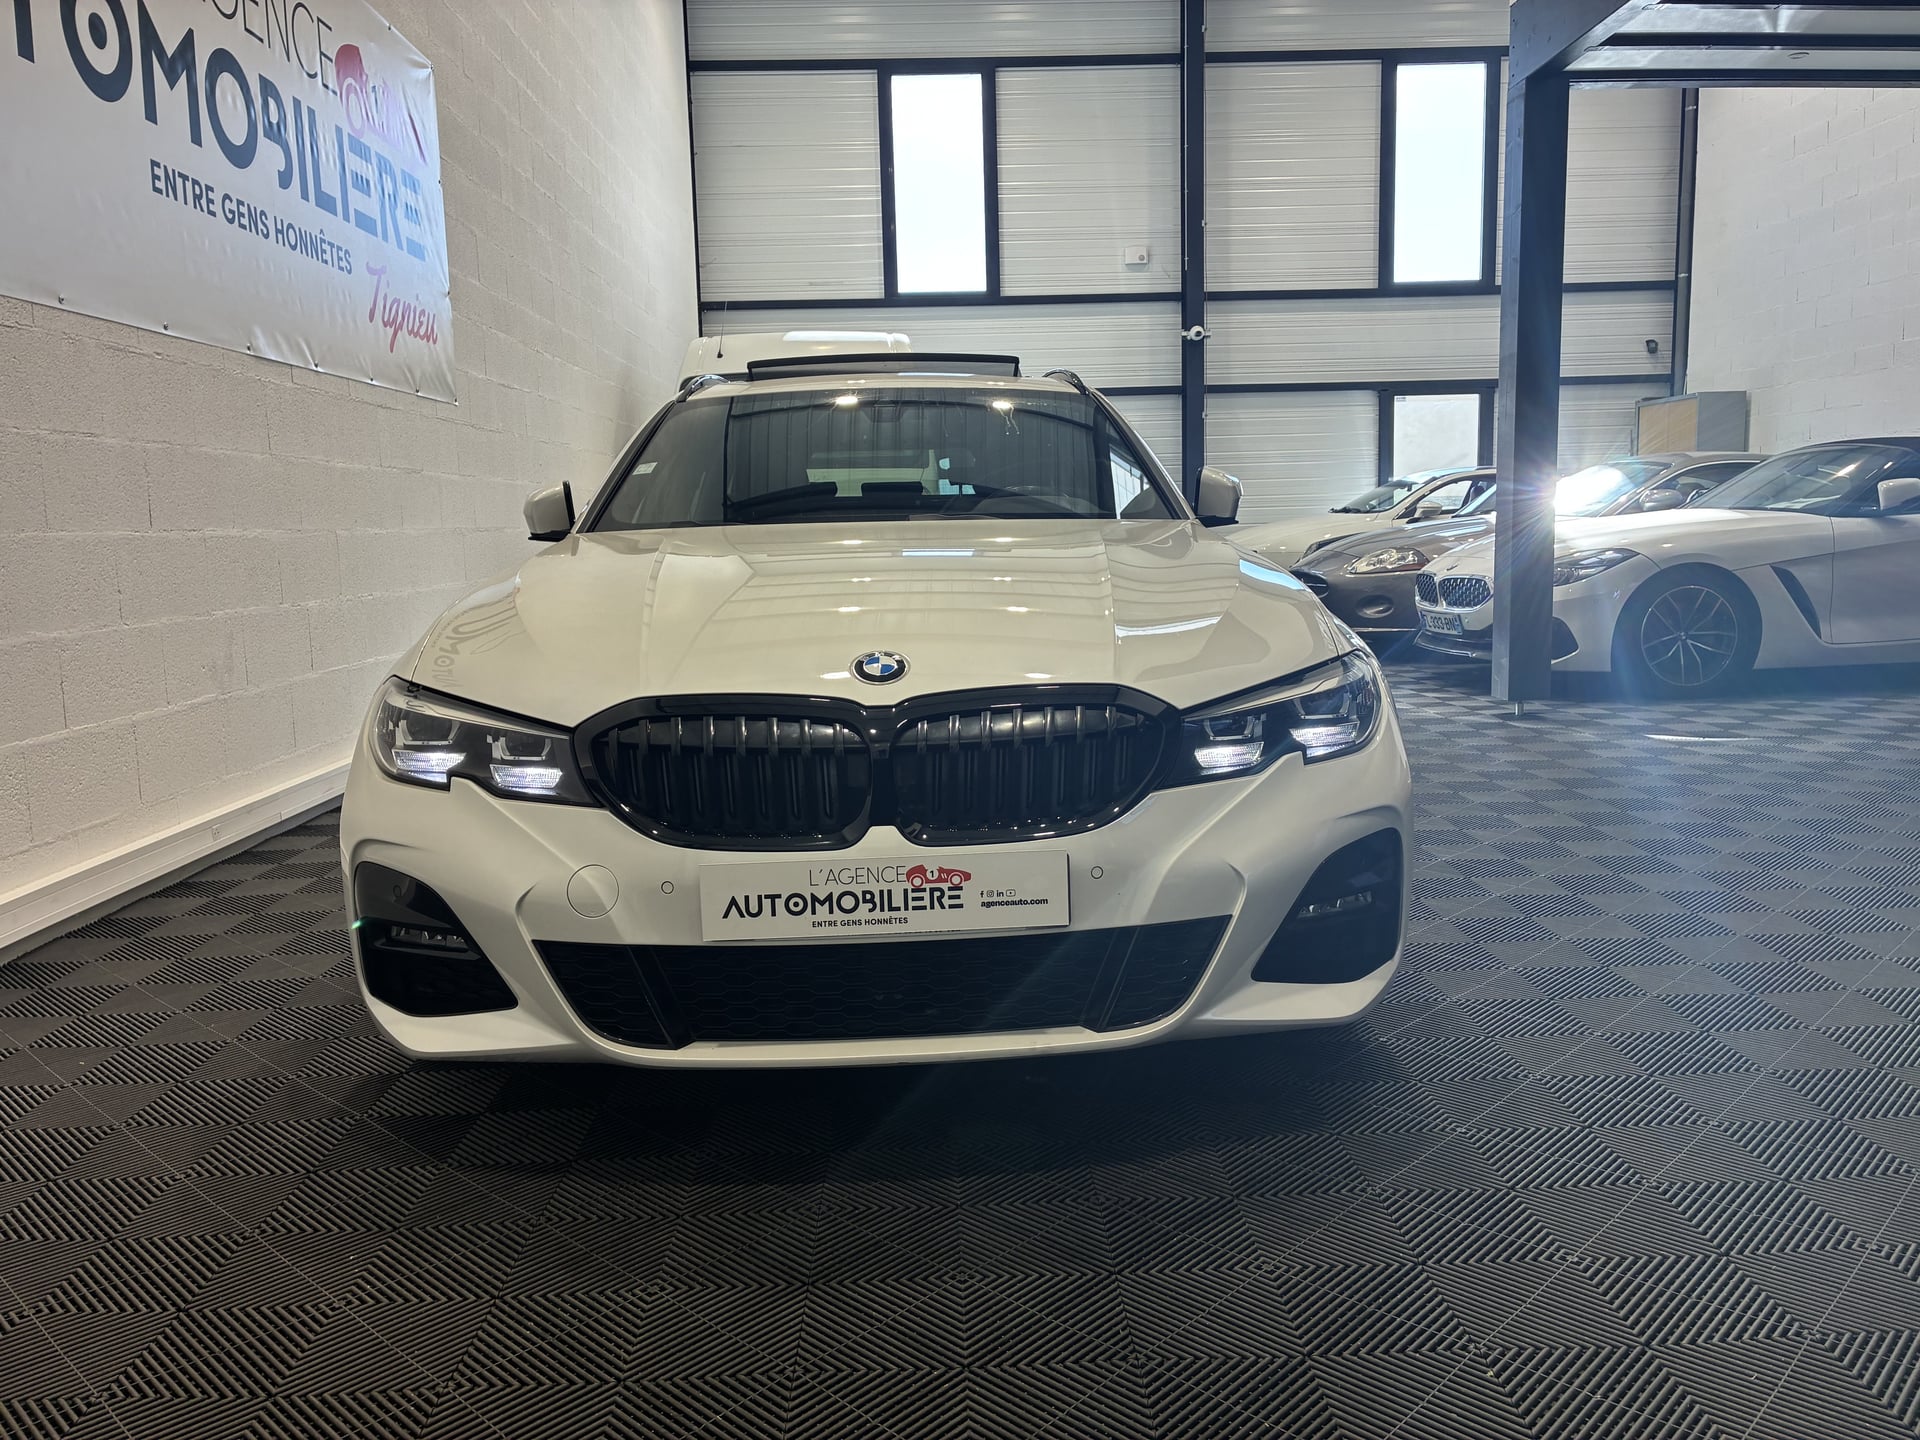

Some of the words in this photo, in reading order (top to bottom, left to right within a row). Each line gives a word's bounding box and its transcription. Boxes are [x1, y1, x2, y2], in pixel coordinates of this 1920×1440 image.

[150, 158, 217, 218] ENTRE
[221, 192, 270, 240] GENS
[273, 215, 352, 275] HONNÊTES
[366, 261, 438, 353] Tignieu
[808, 865, 907, 887] L'AGENCE
[722, 885, 964, 919] AUTOMOBILIERE
[980, 898, 1049, 908] agenceauto.com
[812, 919, 838, 928] ENTRE
[840, 917, 863, 927] GENS
[864, 915, 909, 926] HONNÊTES
